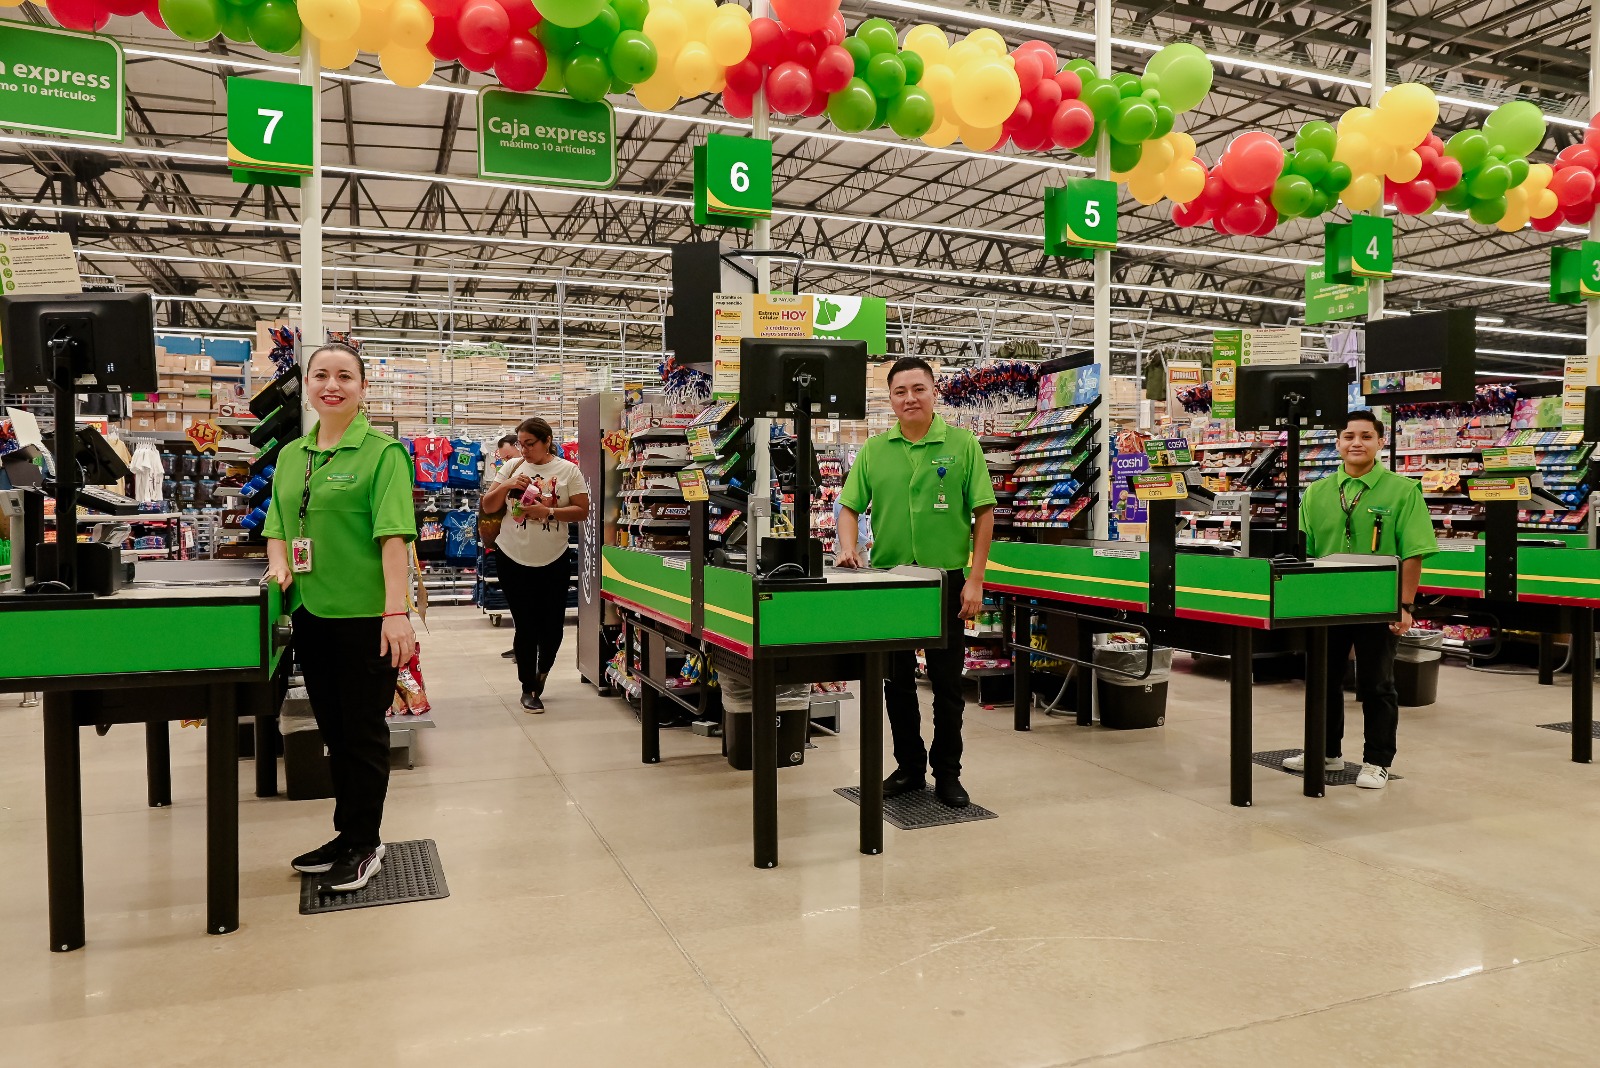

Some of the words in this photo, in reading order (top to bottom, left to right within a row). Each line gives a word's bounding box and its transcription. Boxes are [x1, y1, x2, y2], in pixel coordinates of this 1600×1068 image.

[13, 63, 111, 90] express
[22, 83, 38, 94] 10
[40, 87, 97, 103] artículos
[257, 107, 284, 145] 7
[488, 116, 530, 140] Caja
[534, 124, 606, 144] express
[500, 138, 540, 151] máximo
[542, 142, 554, 151] 10
[555, 144, 597, 156] artículos
[730, 161, 750, 193] 6
[1084, 199, 1101, 228] 5
[1365, 235, 1380, 260] 4
[1311, 271, 1326, 280] Bode
[1592, 259, 1600, 282] 3
[781, 310, 807, 321] HOY
[1117, 457, 1143, 469] cashi
